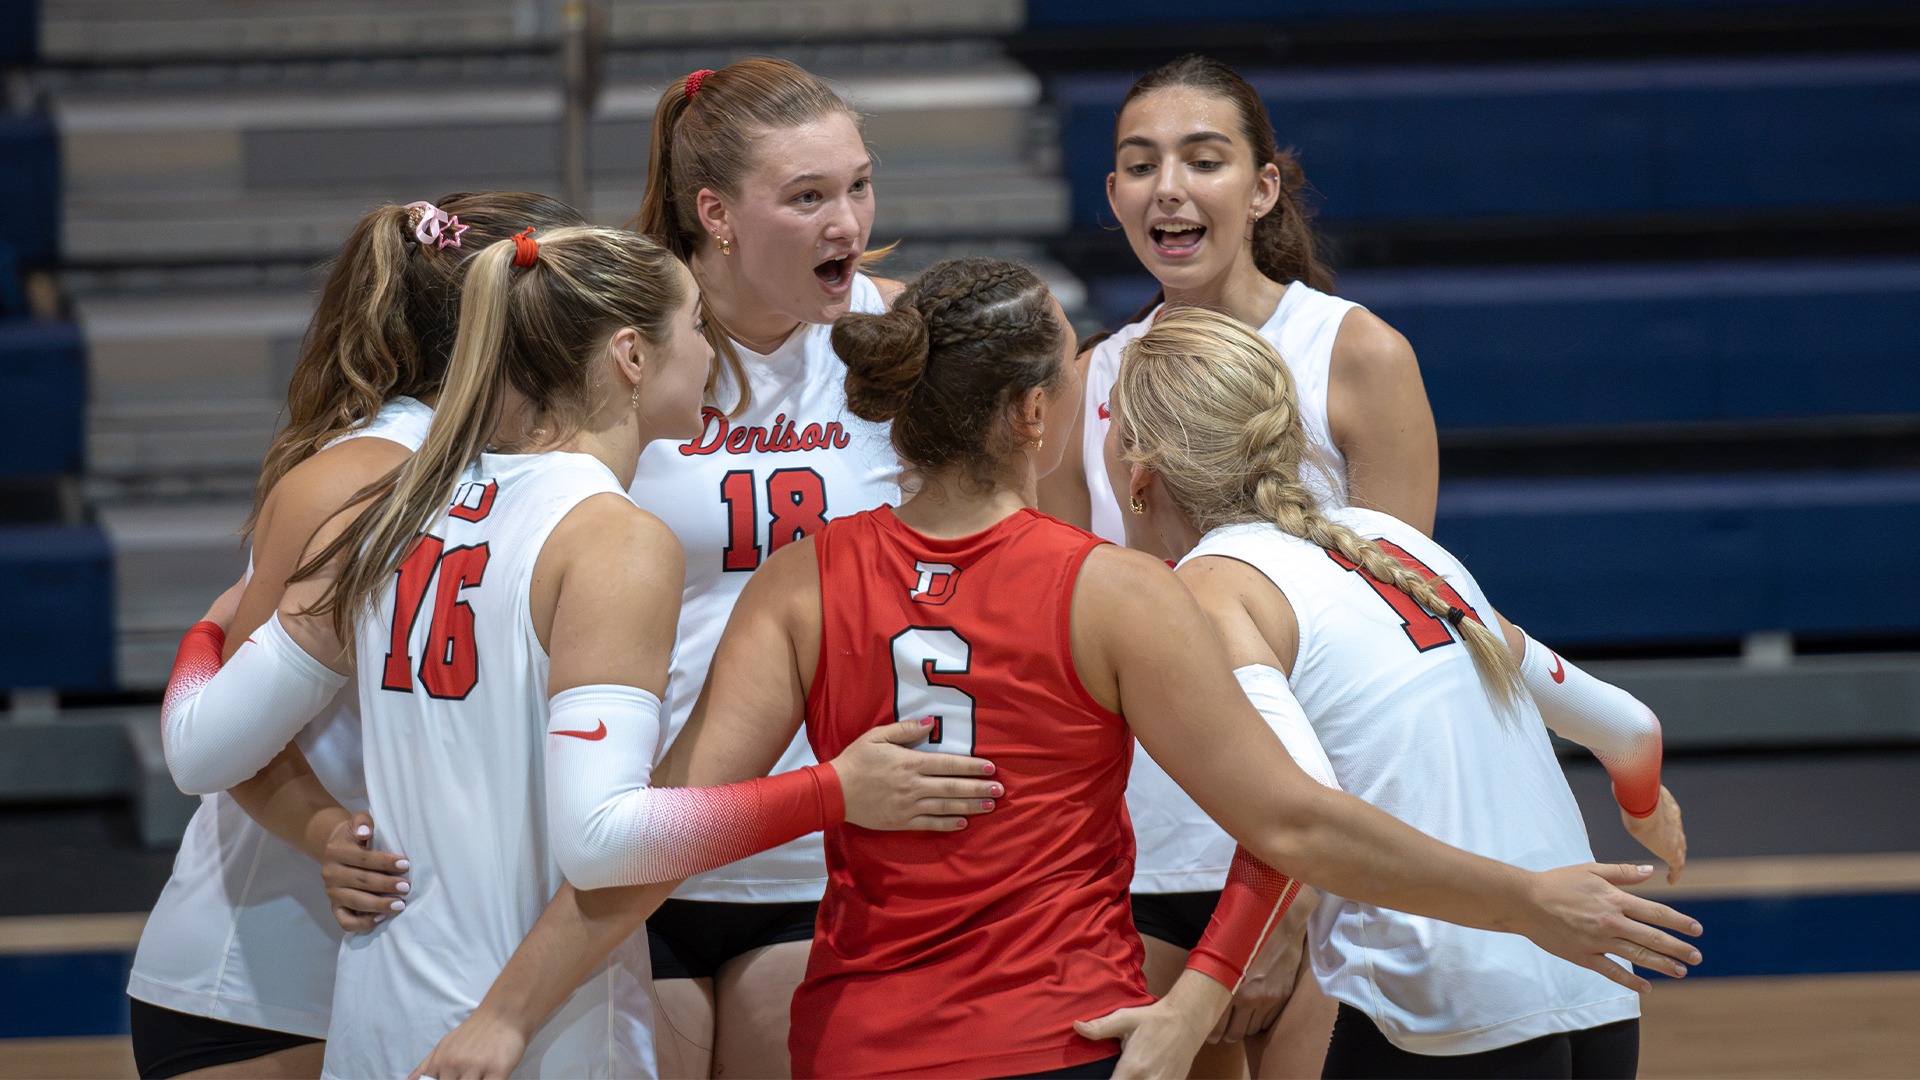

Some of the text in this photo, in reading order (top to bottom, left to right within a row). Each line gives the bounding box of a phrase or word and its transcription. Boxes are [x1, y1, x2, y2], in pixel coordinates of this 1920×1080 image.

[679, 406, 850, 456] Denison
[720, 467, 828, 572] 18
[381, 531, 491, 701] 16
[909, 560, 963, 606] D
[890, 624, 976, 757] 6
